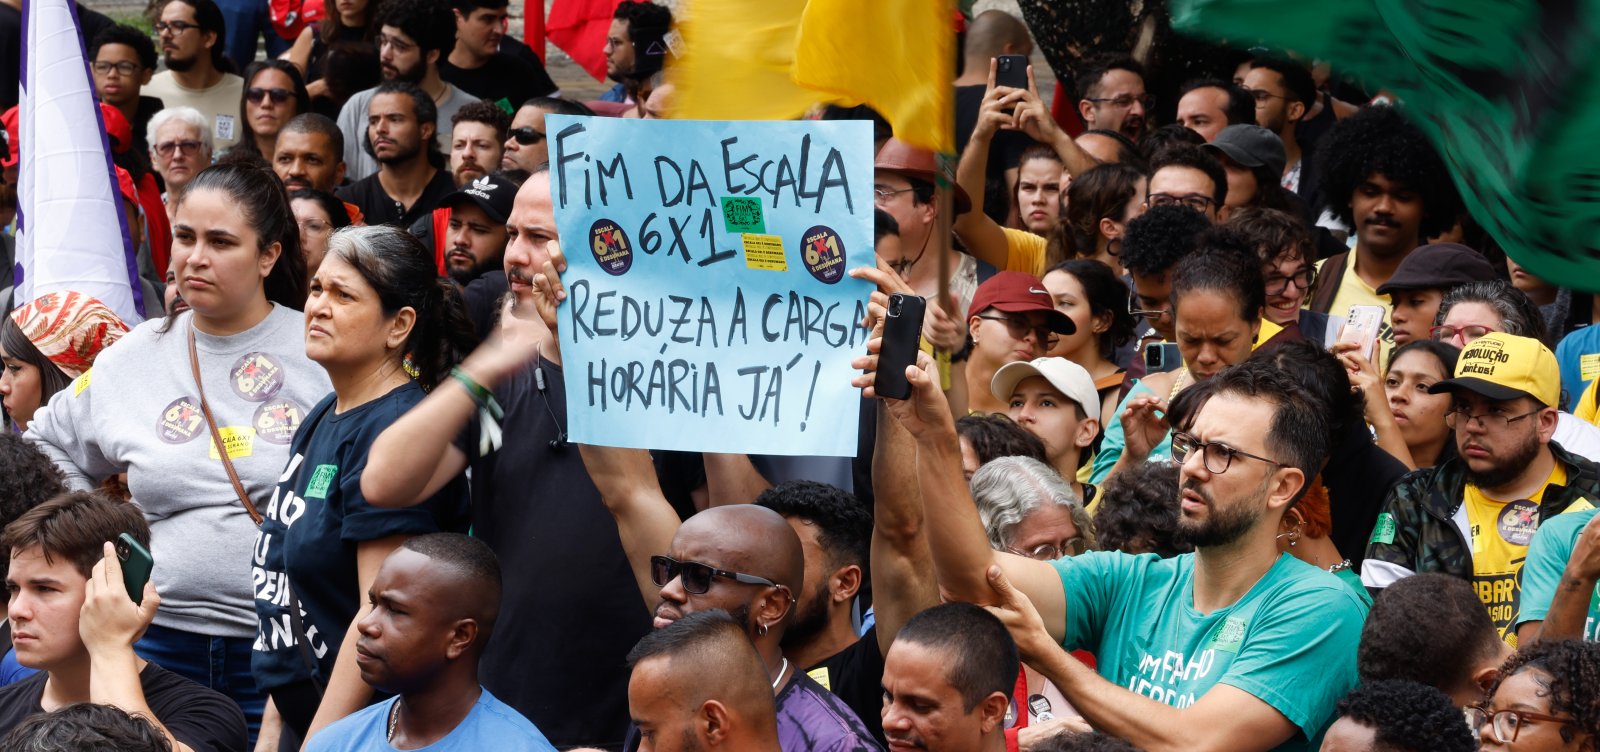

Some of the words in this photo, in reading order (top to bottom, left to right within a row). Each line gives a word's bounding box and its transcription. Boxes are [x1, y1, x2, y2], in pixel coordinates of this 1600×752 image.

[655, 156, 717, 207] DA
[720, 133, 854, 215] ESCALA
[595, 225, 614, 234] ESCALA
[639, 208, 737, 266] 6X1
[807, 231, 828, 244] ESCALA
[570, 279, 718, 348] REDUZA
[728, 286, 747, 346] A
[762, 290, 868, 349] CARGA
